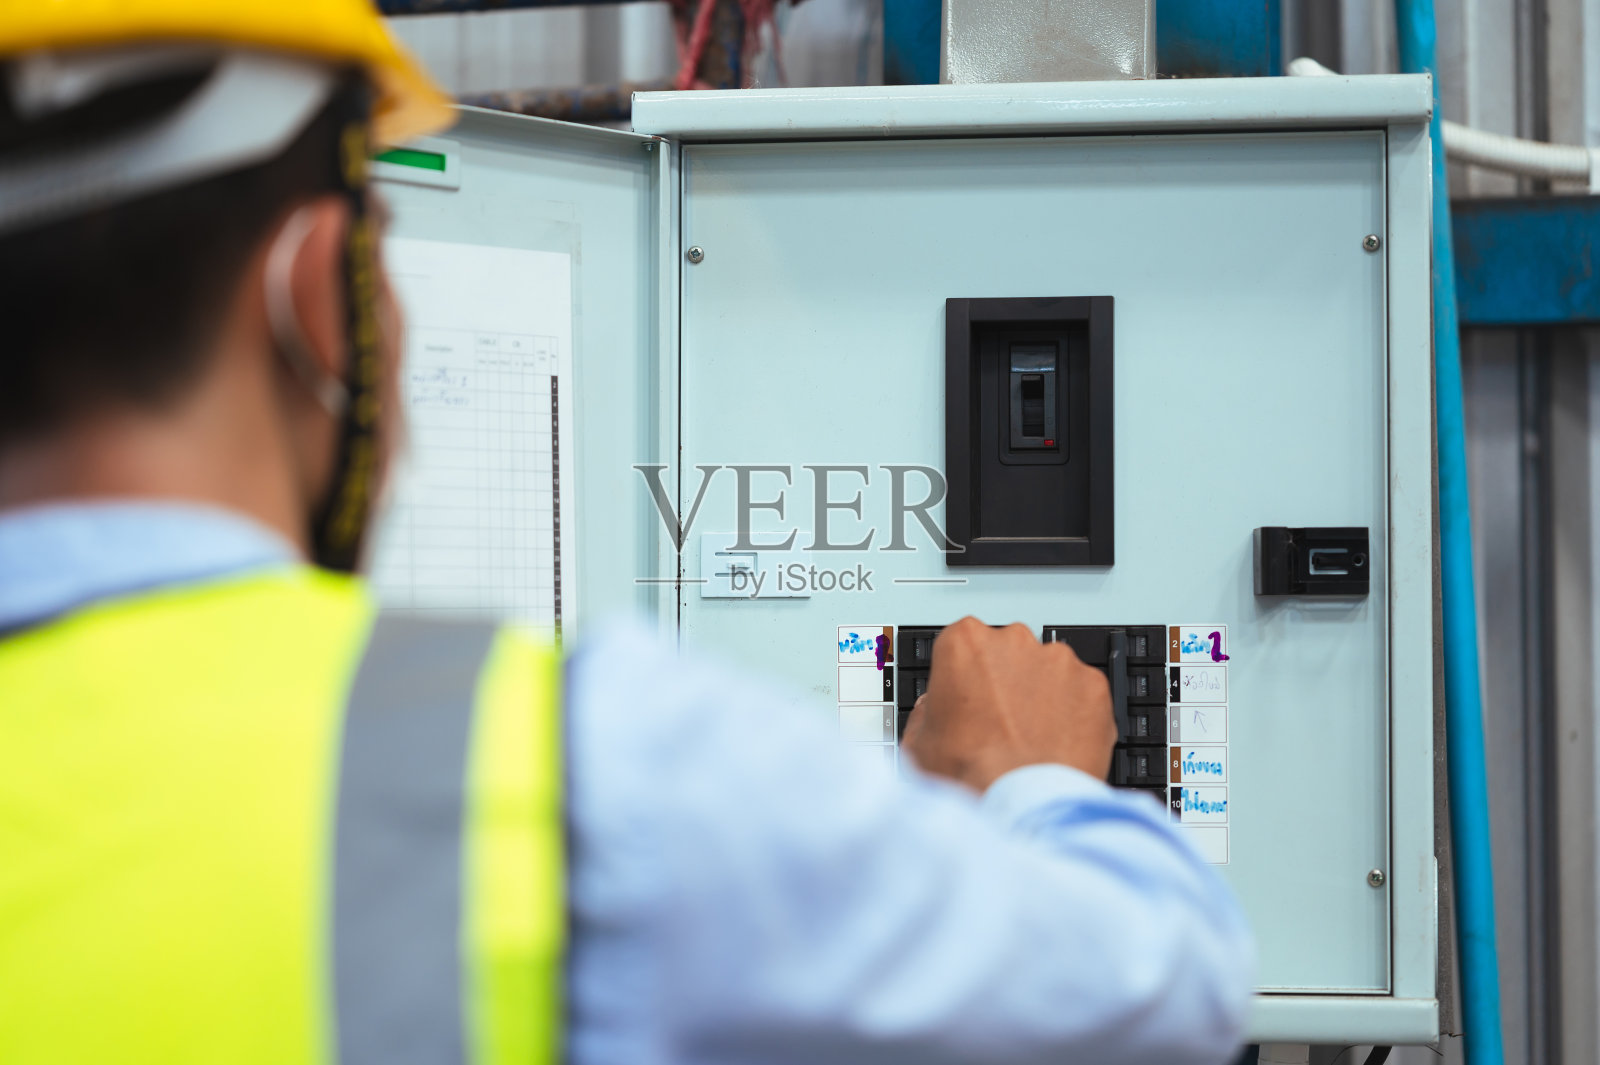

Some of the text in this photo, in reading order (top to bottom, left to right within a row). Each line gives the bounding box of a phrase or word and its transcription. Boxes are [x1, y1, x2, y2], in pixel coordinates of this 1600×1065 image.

[1172, 640, 1178, 648] 2
[885, 719, 891, 727] 5
[1172, 720, 1178, 728] 6
[1173, 760, 1179, 768] 8
[1171, 800, 1181, 808] 10
